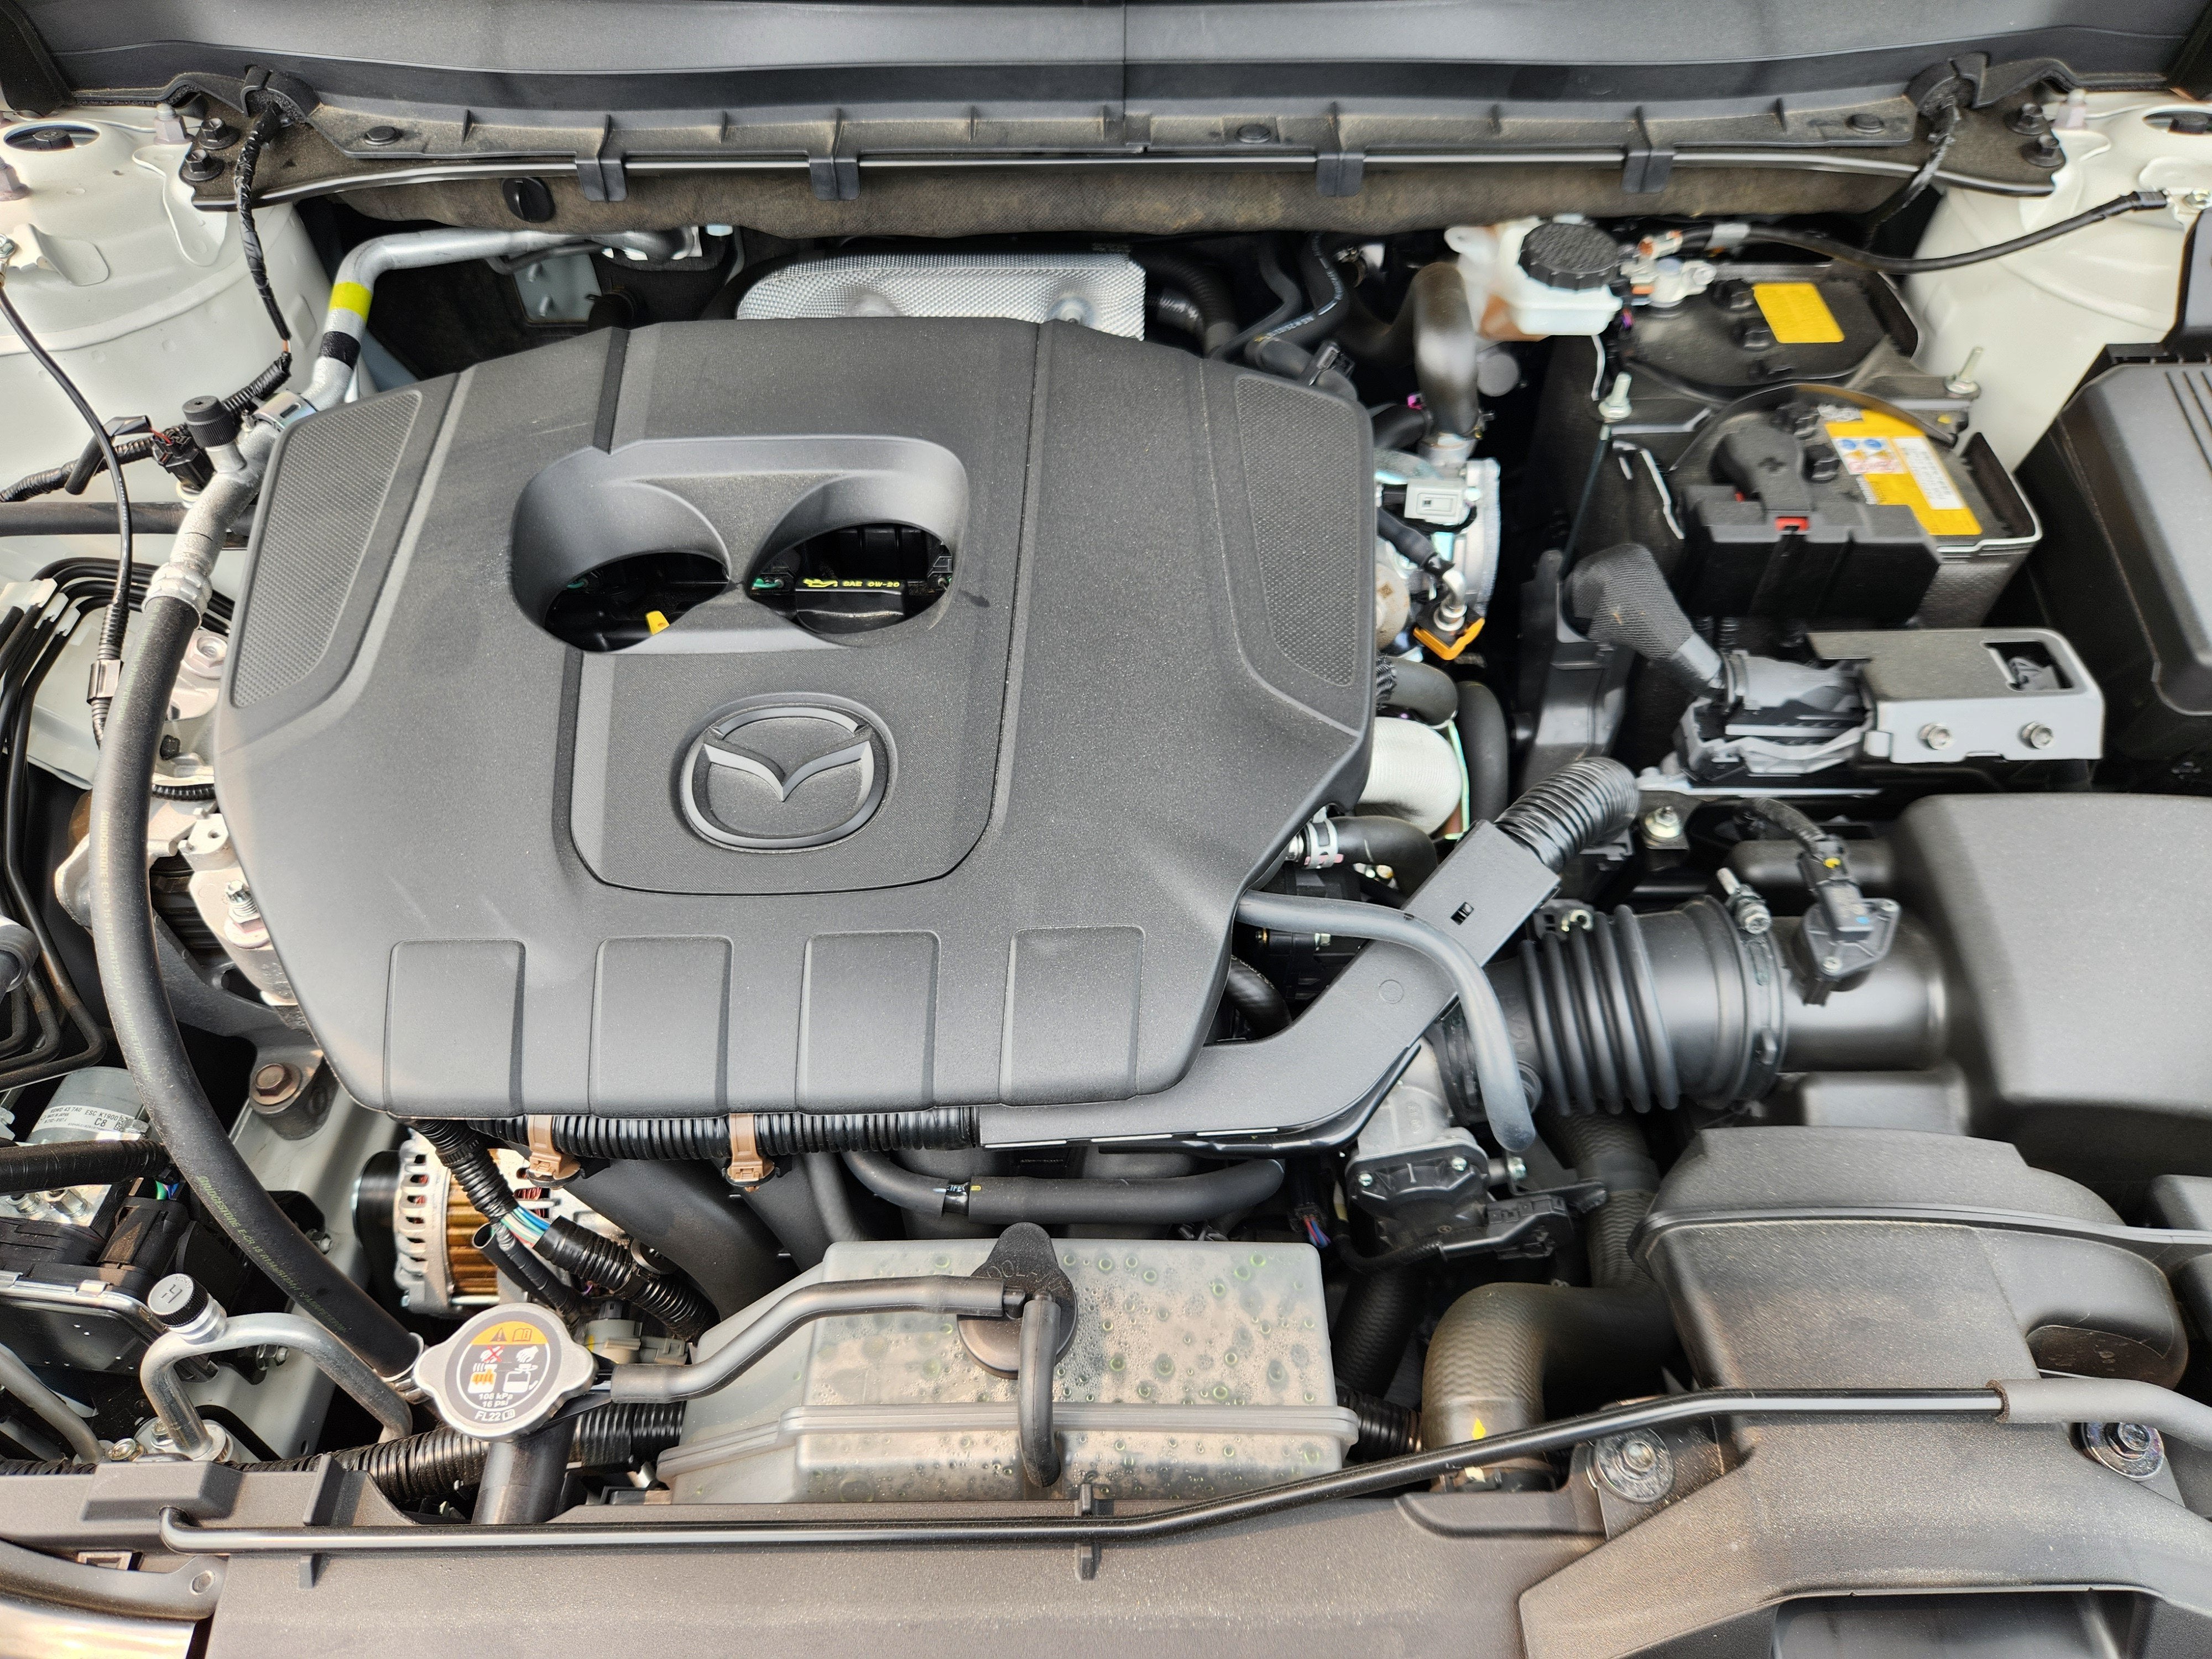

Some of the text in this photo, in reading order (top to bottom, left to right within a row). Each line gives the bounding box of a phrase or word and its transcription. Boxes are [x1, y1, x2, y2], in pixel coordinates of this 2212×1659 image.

[98, 1112, 118, 1121] K1900
[94, 1118, 108, 1128] C8
[196, 1176, 241, 1228] BRIDGESTONE
[495, 1392, 513, 1400] kPa
[493, 1399, 509, 1408] psi
[474, 1410, 501, 1422] FL22
